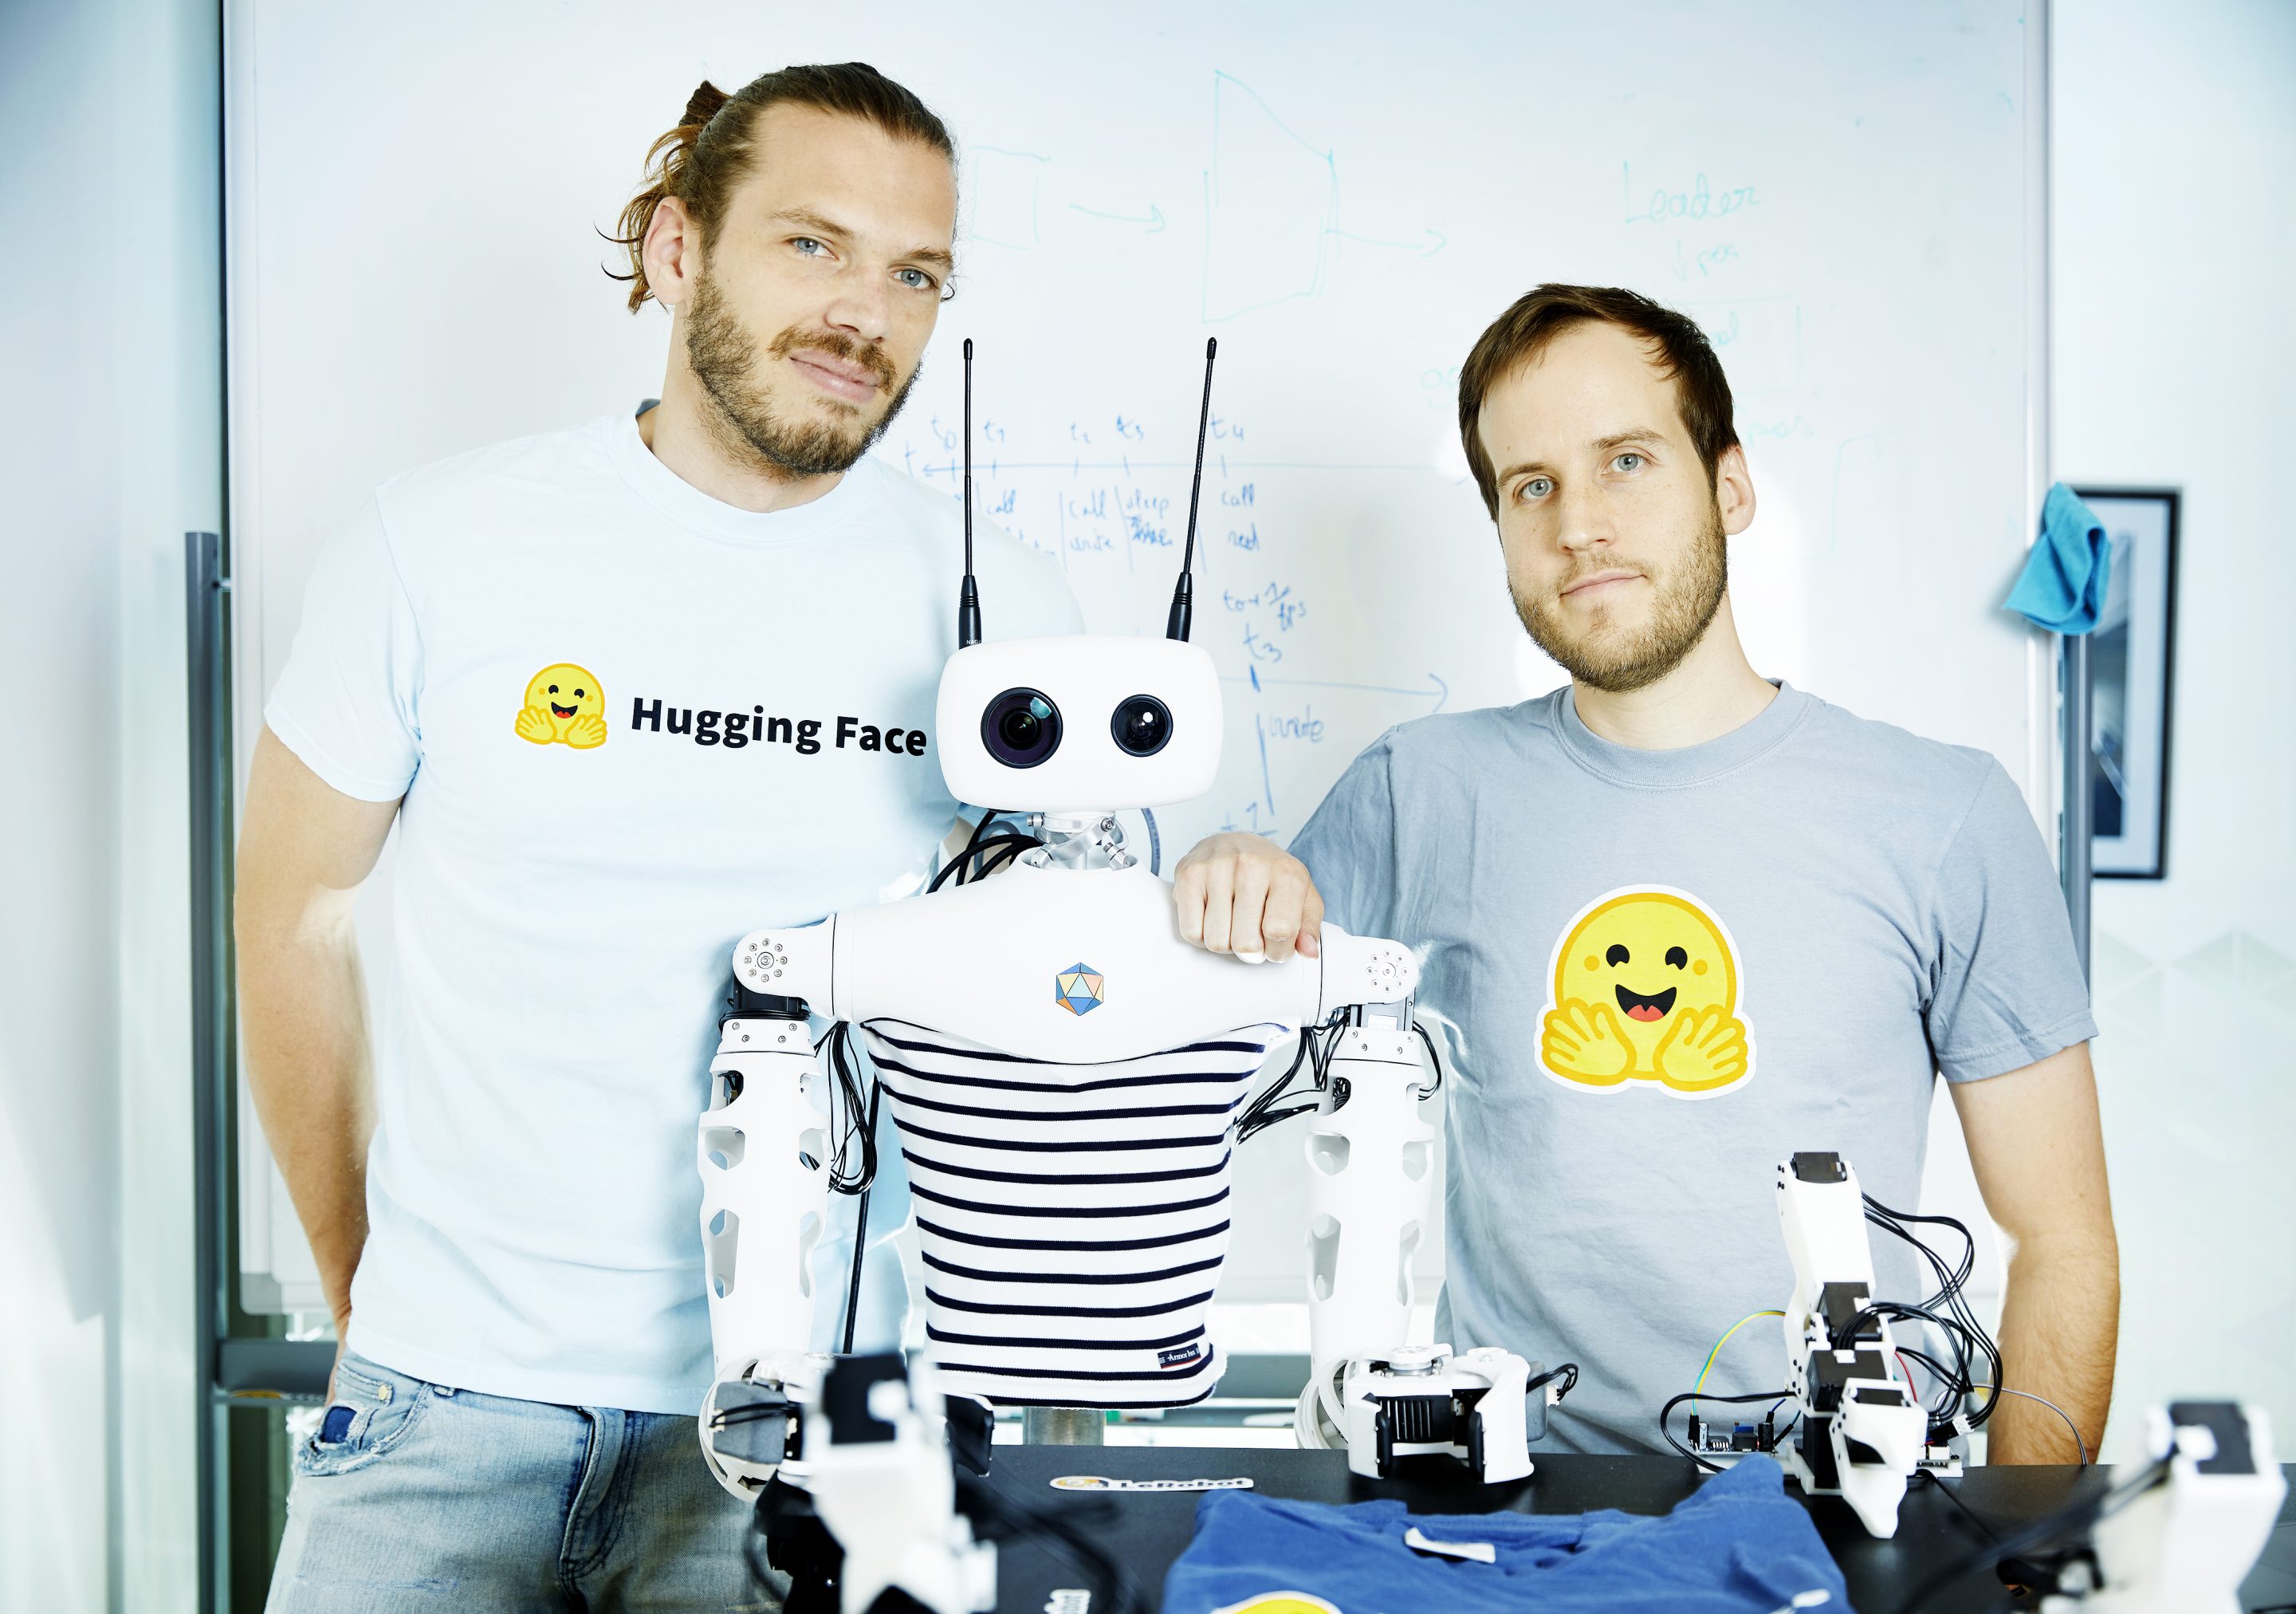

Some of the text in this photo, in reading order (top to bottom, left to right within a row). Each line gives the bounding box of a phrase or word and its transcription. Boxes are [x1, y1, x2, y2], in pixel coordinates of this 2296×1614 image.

[1623, 159, 1762, 224] Leader
[1221, 482, 1255, 506] call
[631, 696, 927, 757] Hugging Face
[1121, 1479, 1244, 1489] LeRobot
